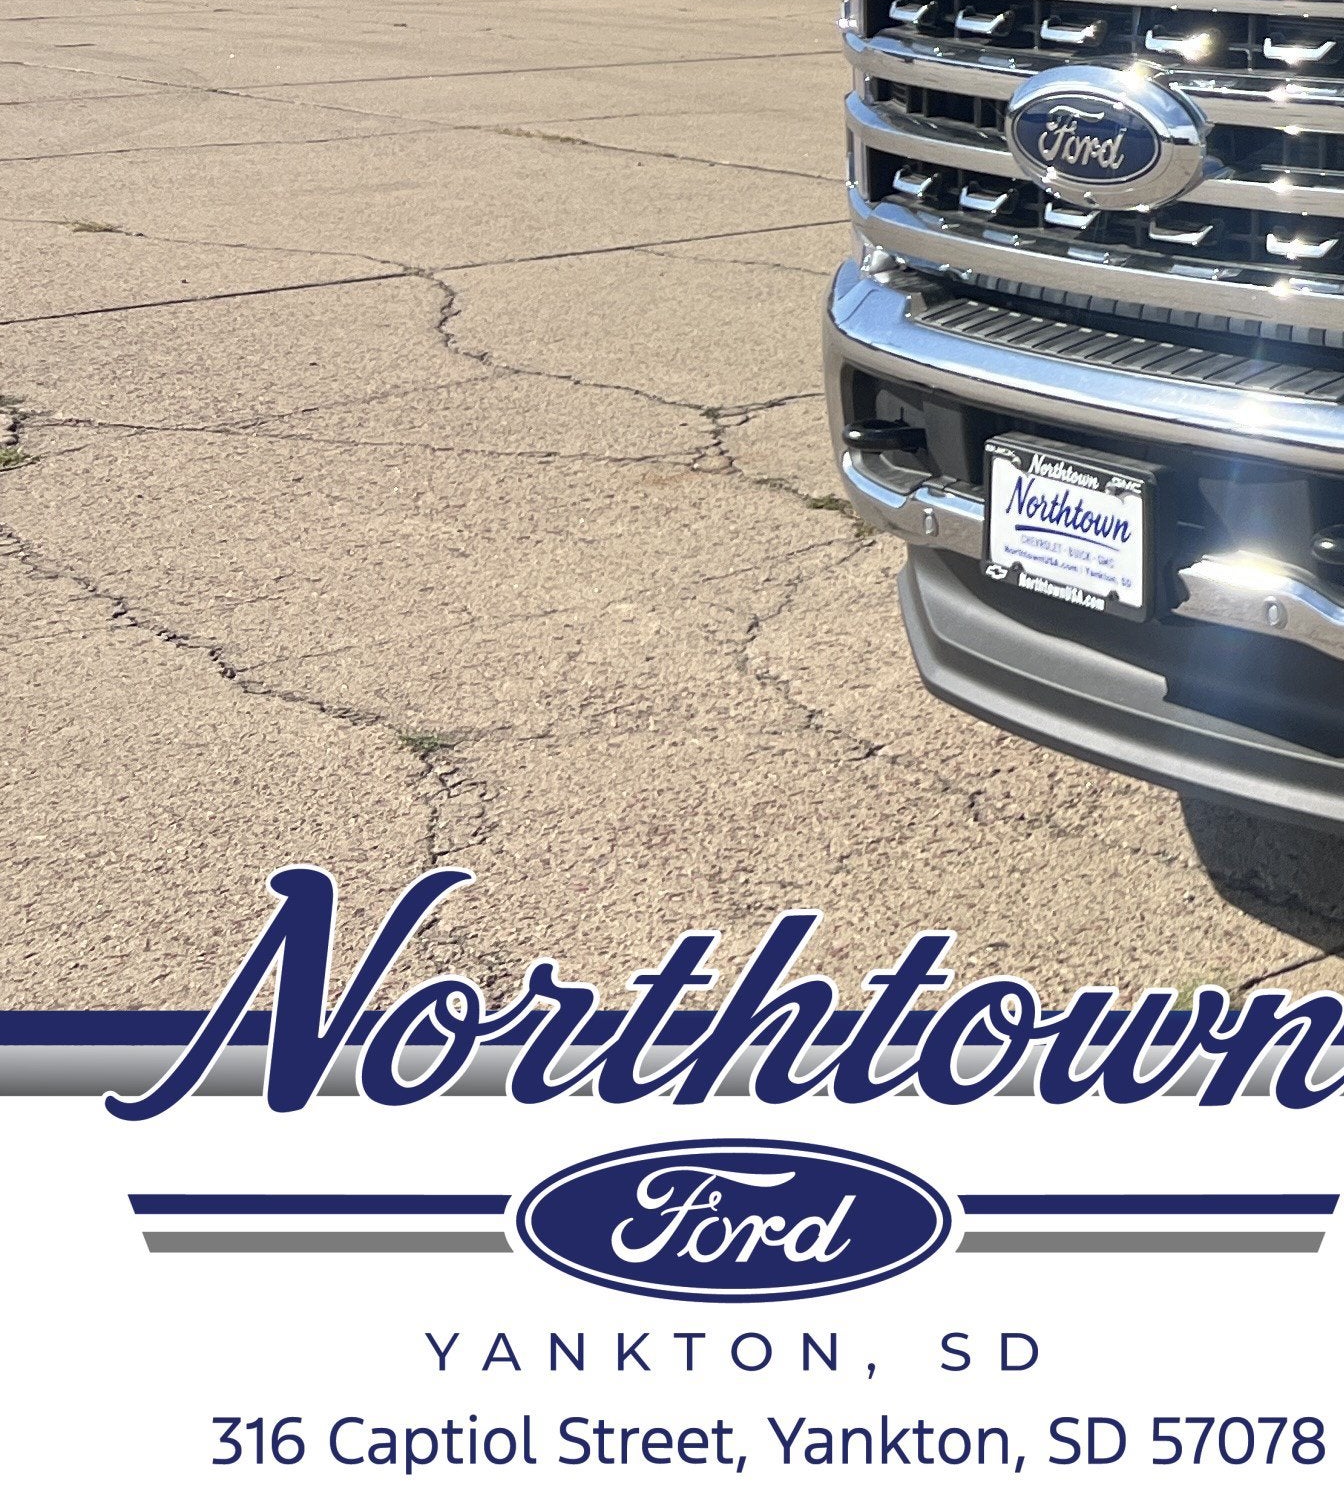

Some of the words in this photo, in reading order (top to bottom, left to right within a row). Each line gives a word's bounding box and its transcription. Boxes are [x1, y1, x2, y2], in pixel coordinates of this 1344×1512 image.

[1037, 104, 1128, 170] Ford
[1028, 453, 1100, 490] Northtown
[1006, 475, 1132, 543] Northtown
[1018, 571, 1106, 612] NorthtownUSA.com
